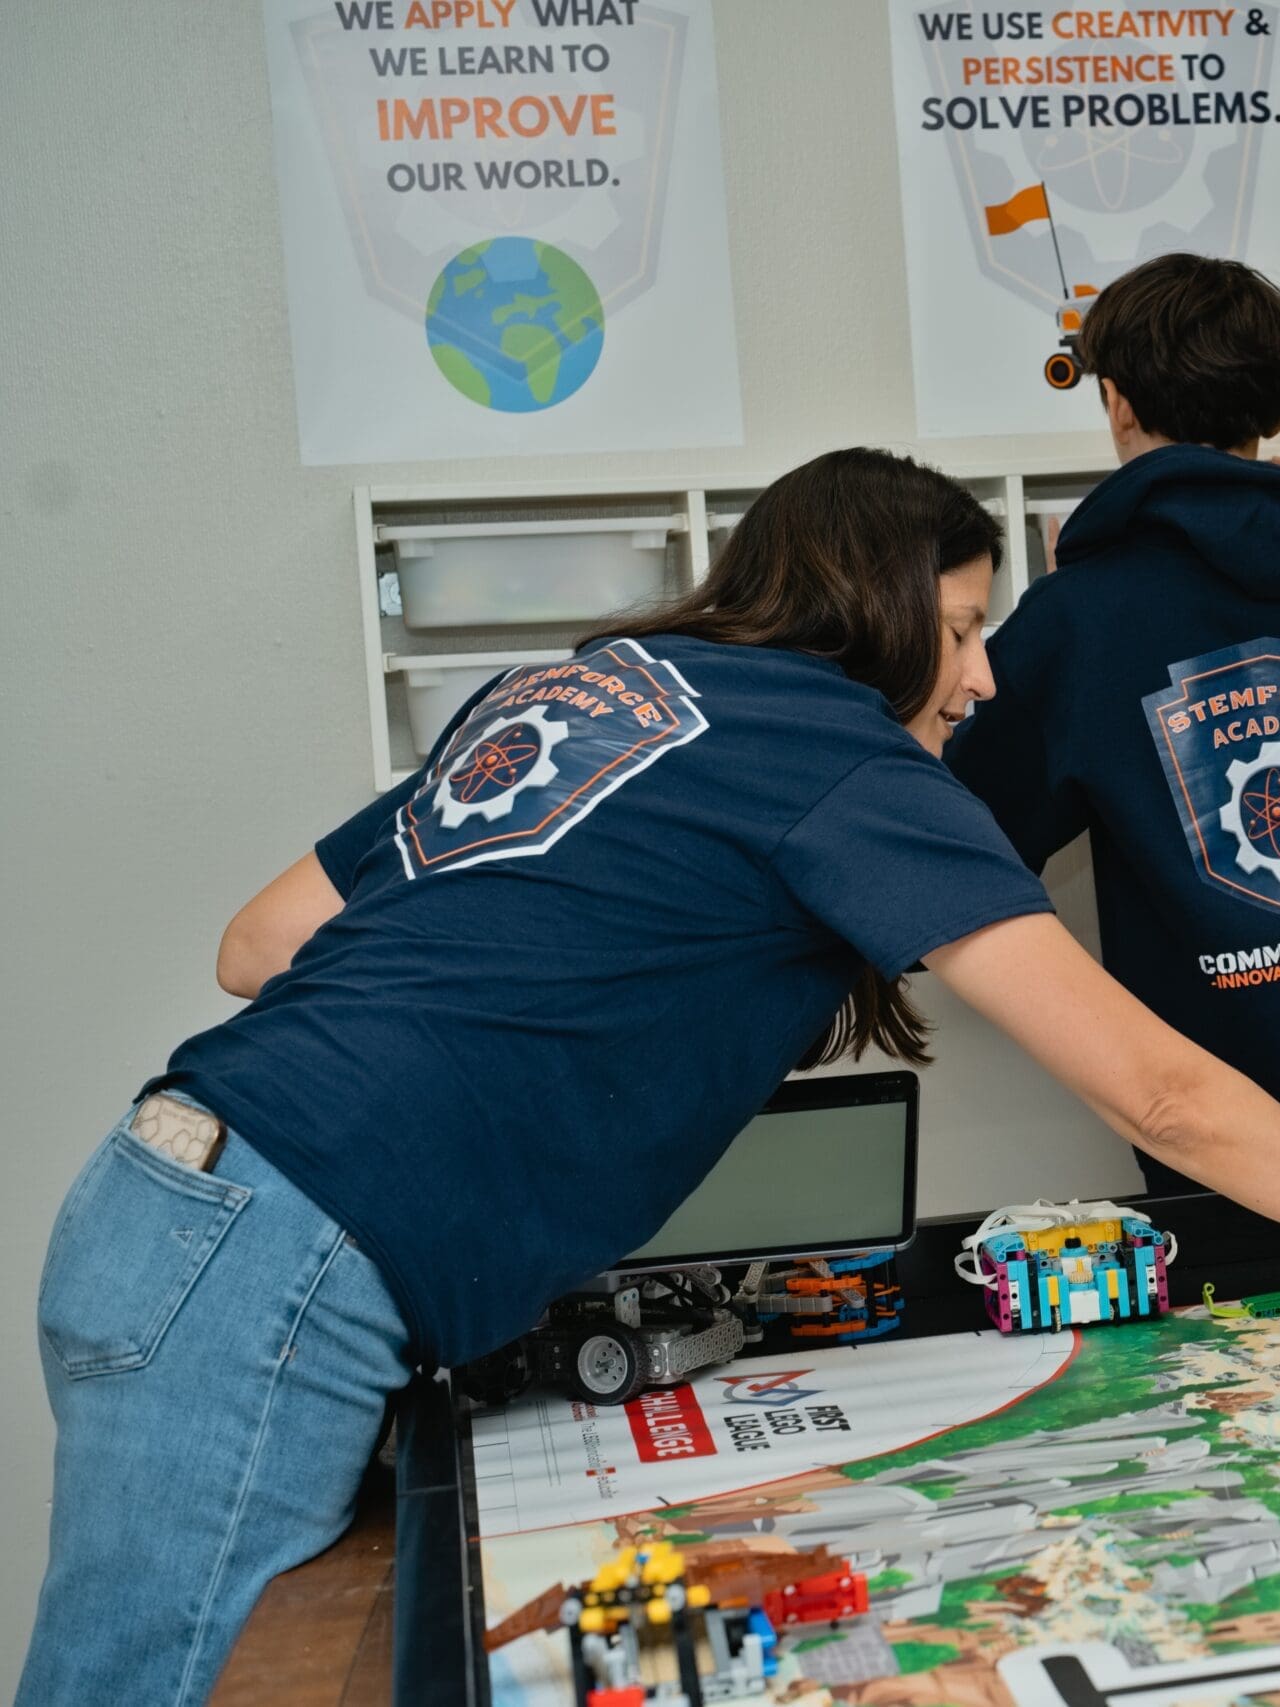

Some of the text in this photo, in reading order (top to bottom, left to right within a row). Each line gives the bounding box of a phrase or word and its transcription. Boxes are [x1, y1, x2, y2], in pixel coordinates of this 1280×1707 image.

[335, 0, 639, 30] WE APPLY WHAT
[919, 8, 1272, 41] WE USE CREATIVITY &
[369, 43, 611, 77] WE LEARN TO
[962, 53, 1226, 86] PERSISTENCE TO
[376, 94, 618, 142] IMPROVE
[921, 95, 1052, 131] SOLVE
[386, 158, 621, 193] OUR WORLD.
[496, 685, 615, 718] ACADEMY
[638, 1390, 695, 1458] CHALLENGE
[723, 1413, 771, 1452] LEAGUE
[764, 1408, 807, 1435] LEGO
[804, 1404, 852, 1432] FIRST
